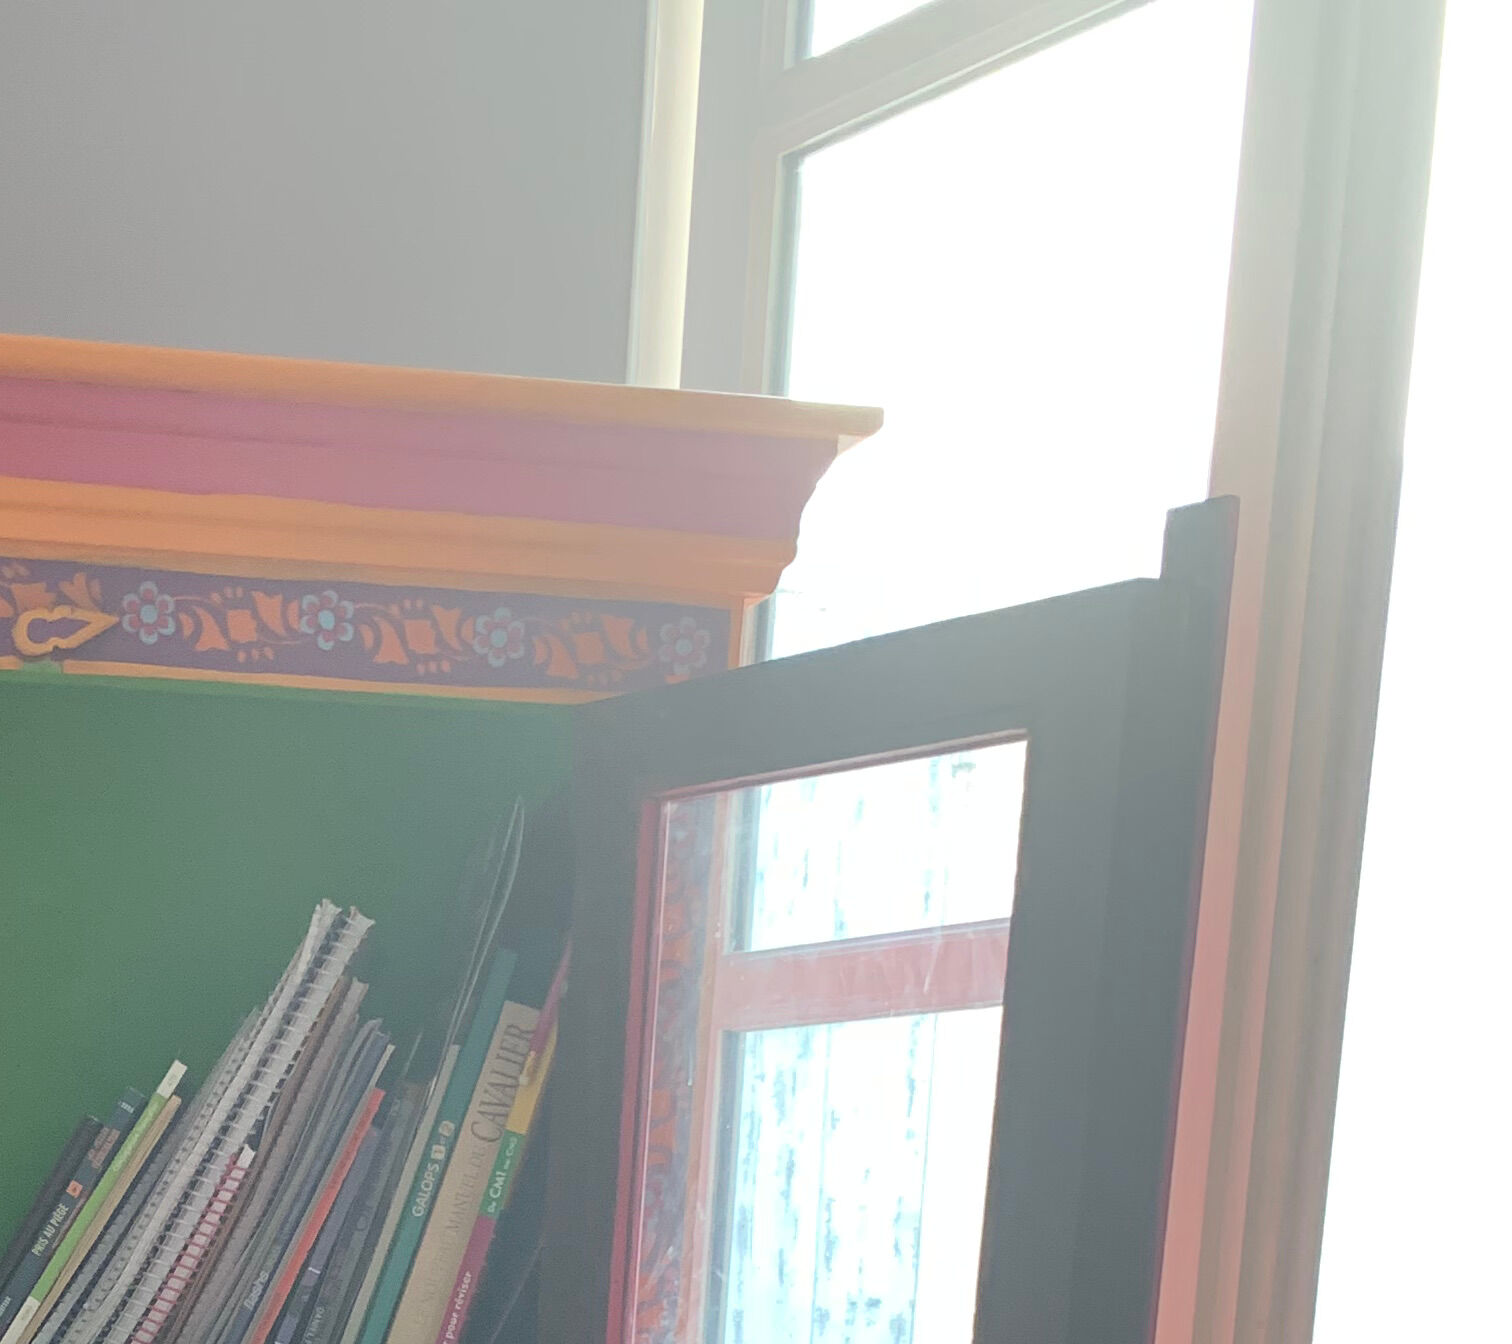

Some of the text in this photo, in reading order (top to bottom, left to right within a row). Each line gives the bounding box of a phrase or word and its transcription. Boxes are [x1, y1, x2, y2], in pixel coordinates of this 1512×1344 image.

[471, 1023, 536, 1143] CAVALIER
[411, 1161, 439, 1218] GALOPS
[489, 1170, 506, 1200] CM1
[31, 1202, 69, 1257] PRIS AU PIÈGE
[445, 1311, 460, 1342] pour
[454, 1271, 472, 1311] réviser
